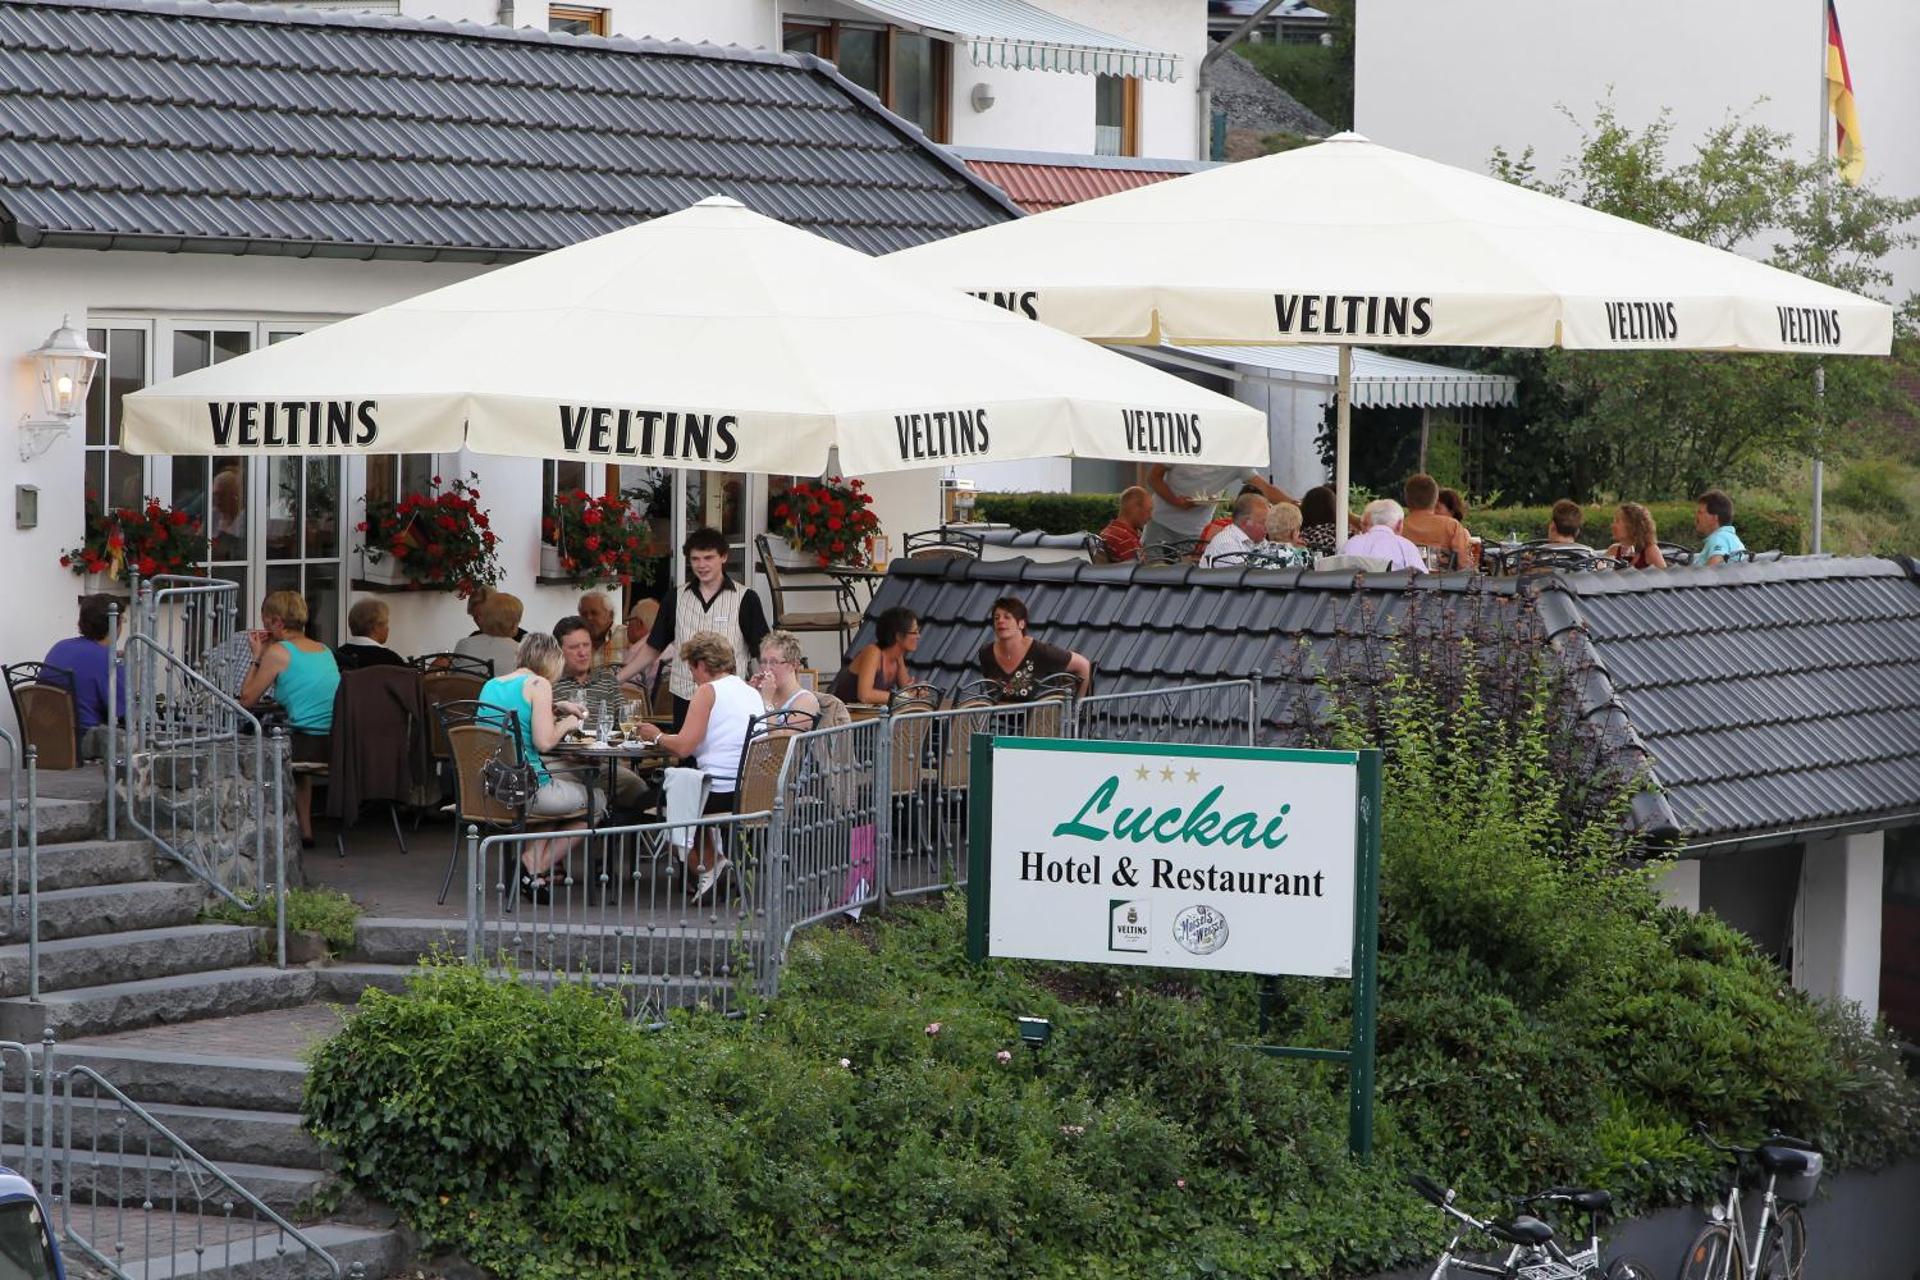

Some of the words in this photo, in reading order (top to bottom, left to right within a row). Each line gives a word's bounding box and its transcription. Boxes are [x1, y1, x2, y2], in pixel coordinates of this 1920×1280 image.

[1274, 293, 1433, 337] VELTINS
[1604, 301, 1679, 342] VELTINS
[1776, 306, 1842, 347] VELTINS
[207, 400, 380, 447] VELTINS
[559, 405, 740, 464] VELTINS
[894, 408, 990, 460] VELTINS
[1121, 408, 1203, 456] VELTINS
[1052, 775, 1292, 850] Luckai
[1020, 851, 1101, 885] Hotel
[1111, 856, 1140, 888] &
[1151, 858, 1325, 897] Restaurant
[1117, 924, 1148, 935] VELTINS
